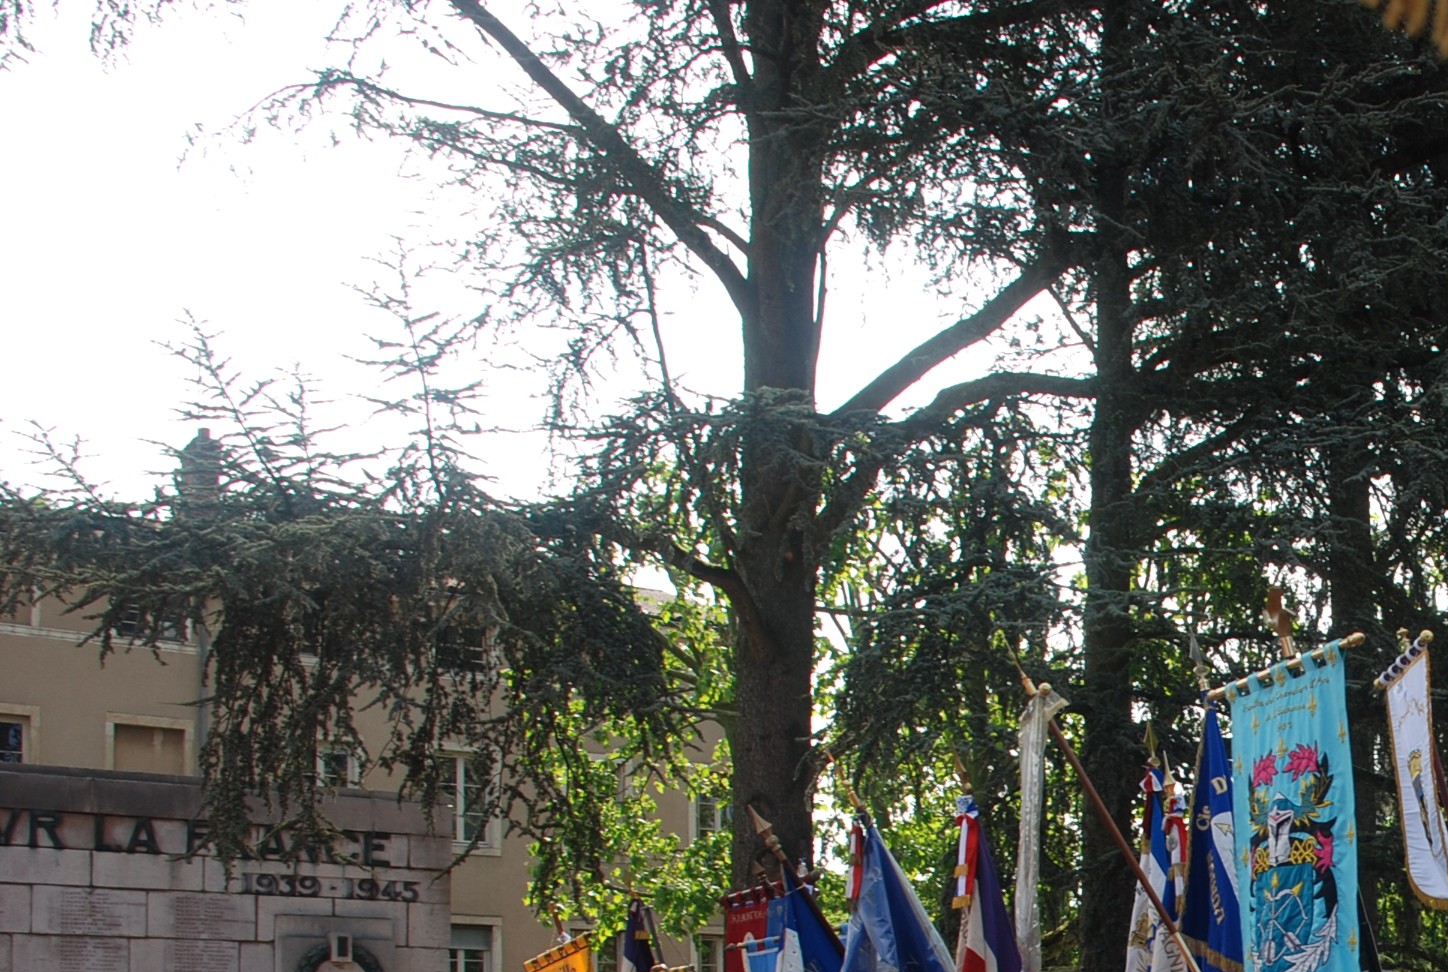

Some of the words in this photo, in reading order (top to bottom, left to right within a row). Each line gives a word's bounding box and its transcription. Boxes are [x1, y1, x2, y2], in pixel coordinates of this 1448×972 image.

[95, 814, 161, 854] LA
[243, 873, 321, 897] 1939
[349, 878, 420, 901] 1945
